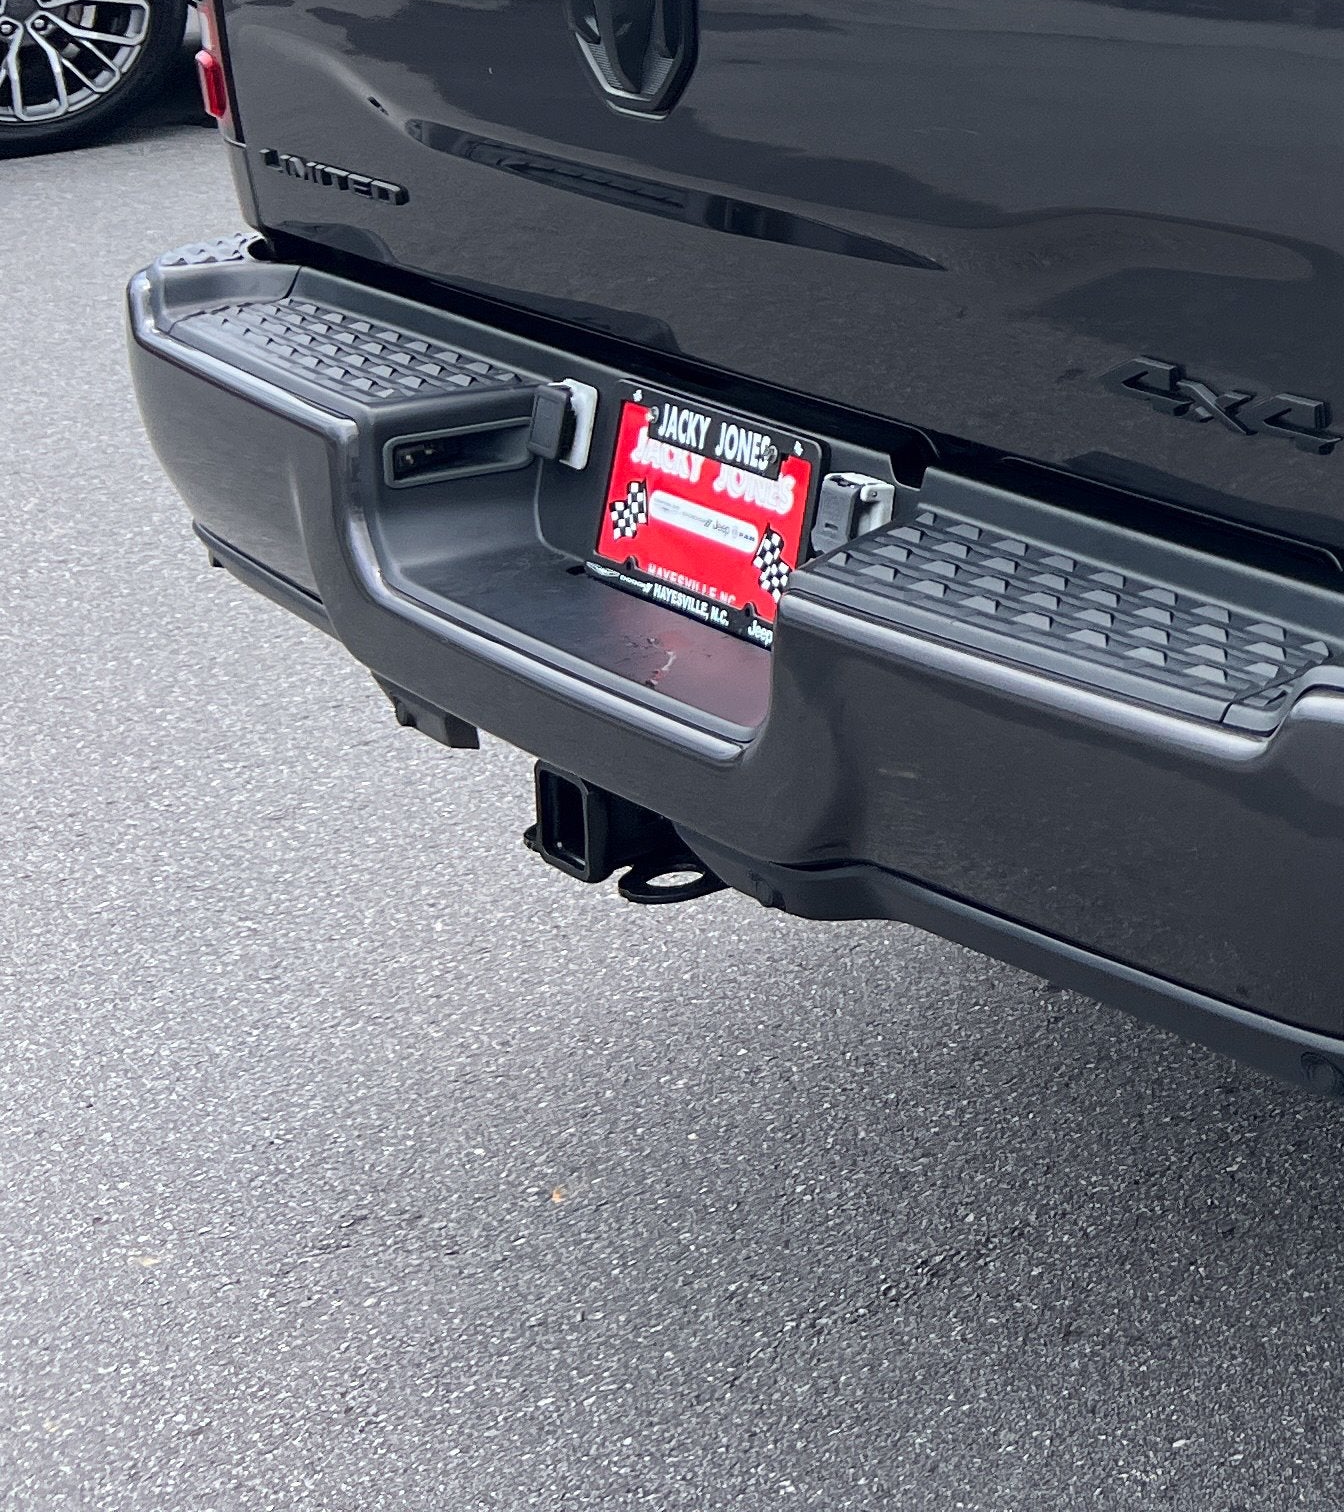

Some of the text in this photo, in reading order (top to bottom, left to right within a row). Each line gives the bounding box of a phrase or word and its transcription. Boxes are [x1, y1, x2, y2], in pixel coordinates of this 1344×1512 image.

[259, 147, 410, 206] LIMITED
[658, 403, 774, 470] JACKY JONES
[747, 620, 774, 648] Jeep
